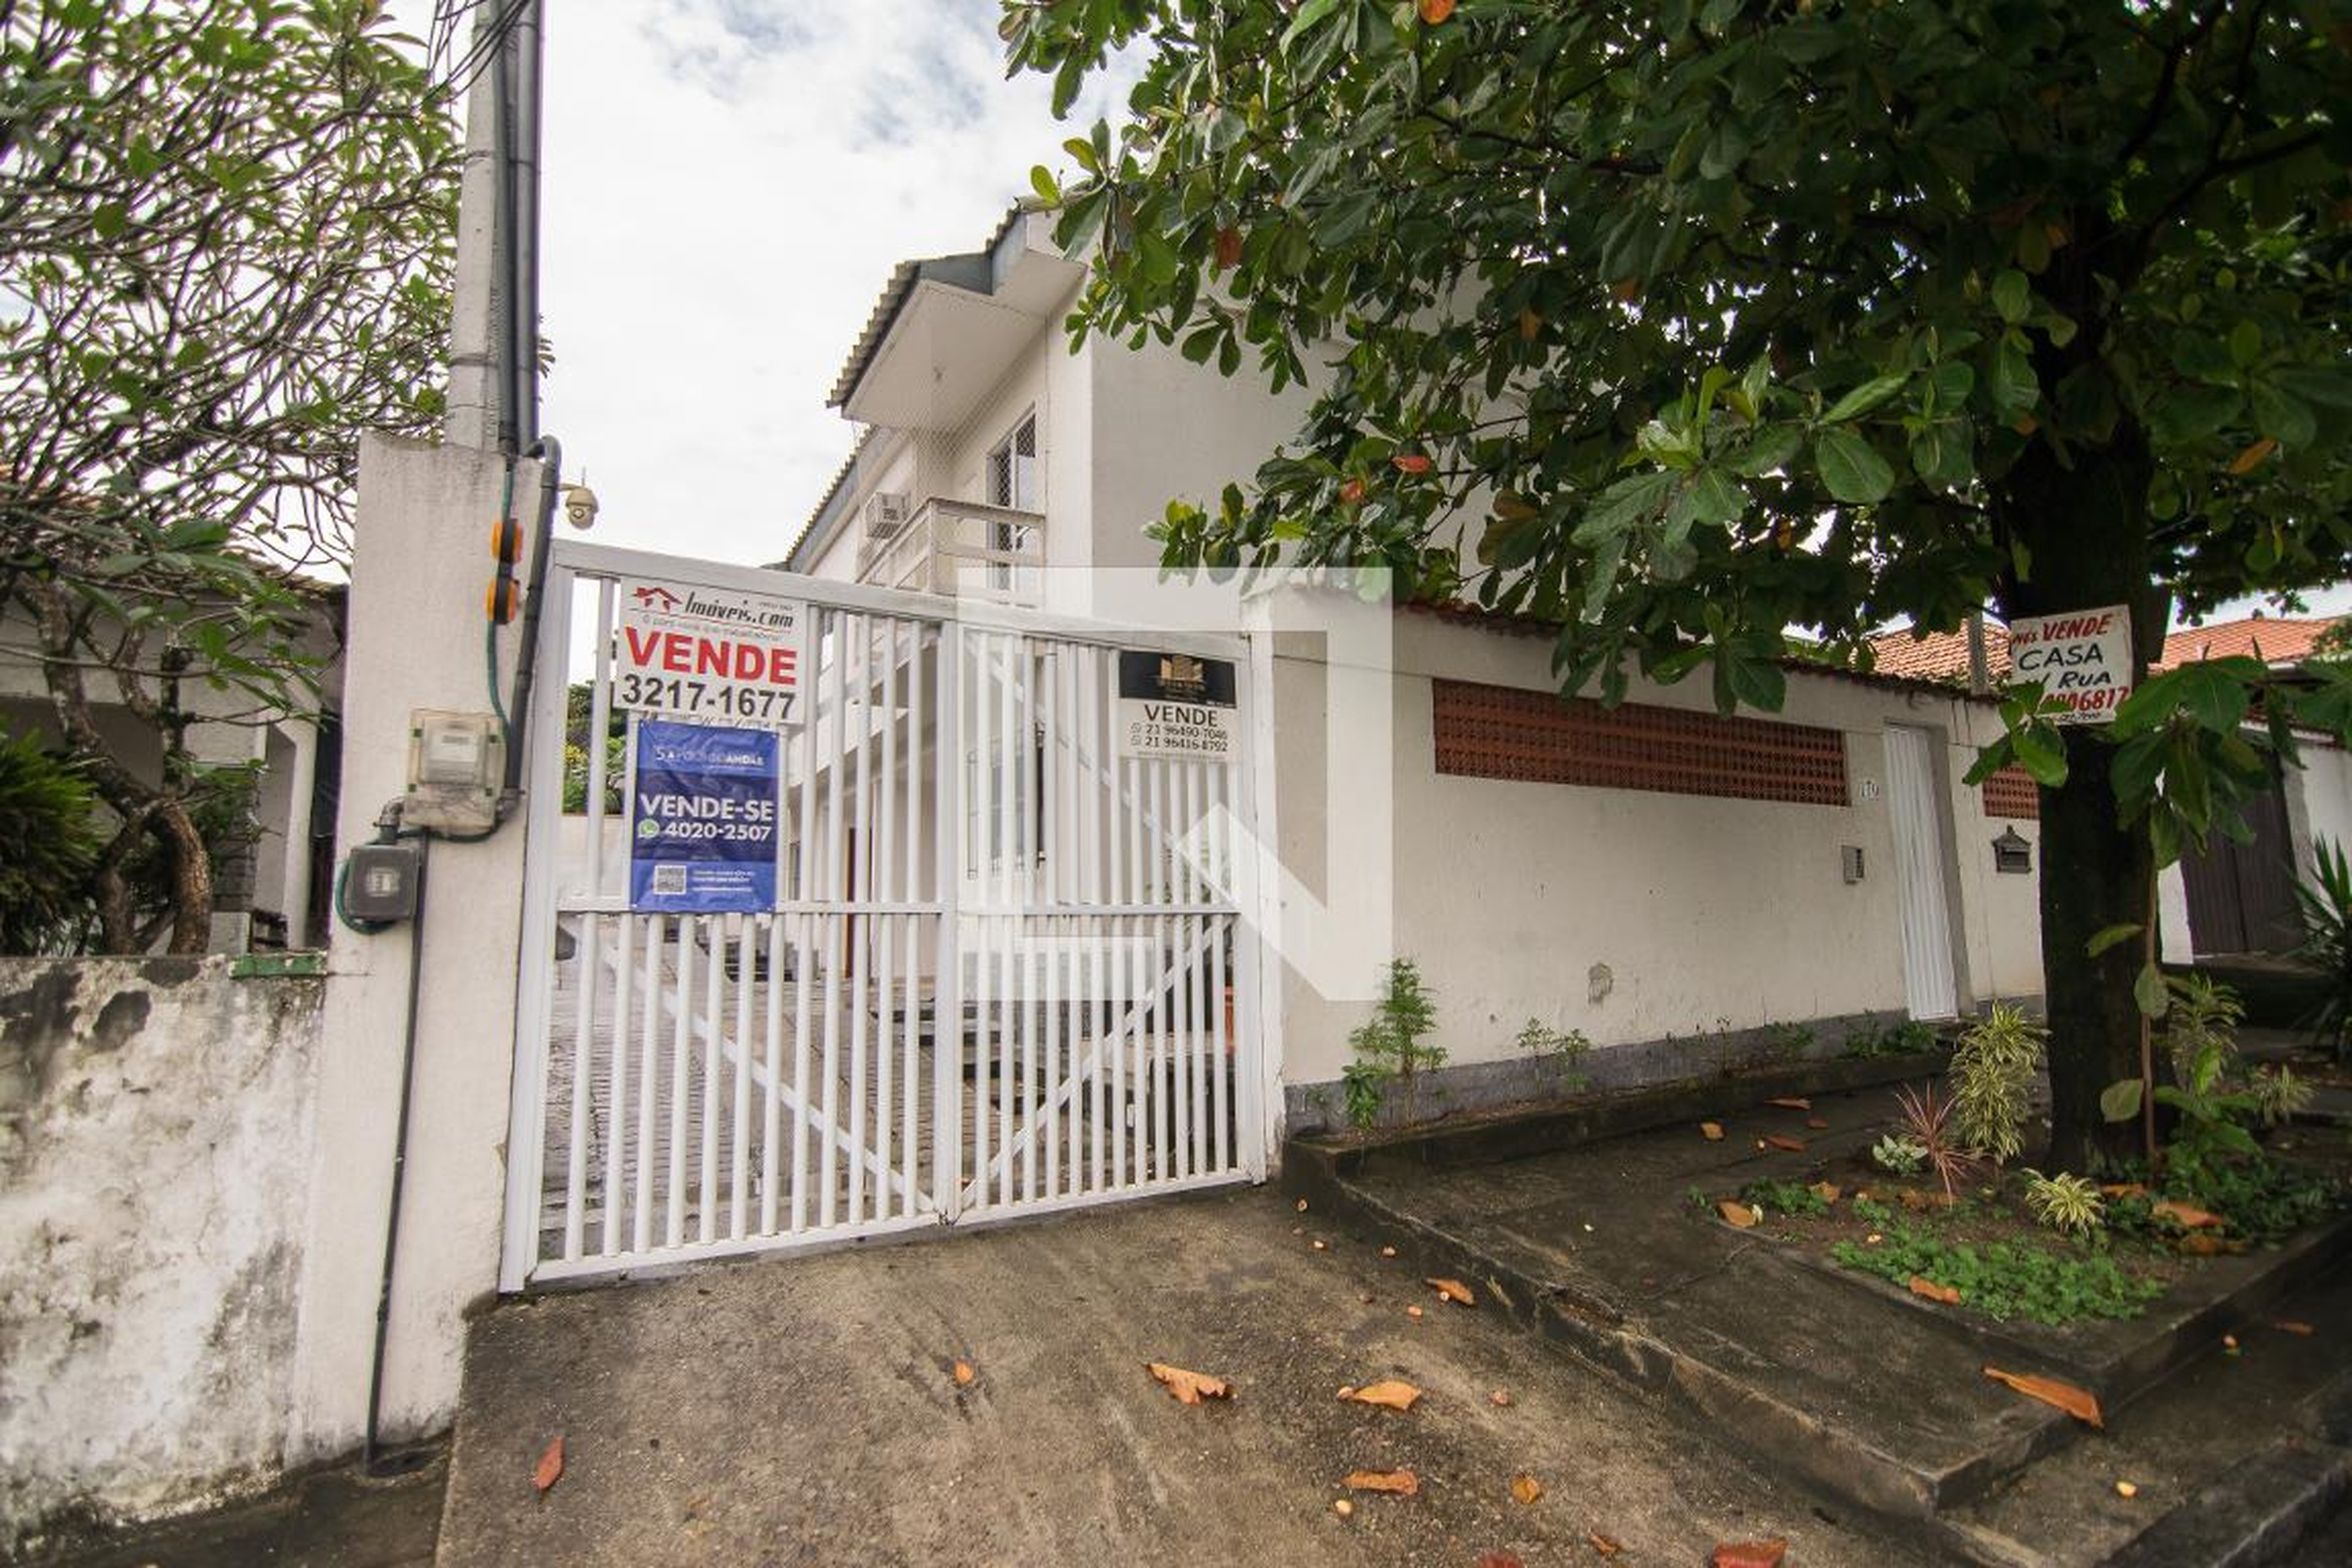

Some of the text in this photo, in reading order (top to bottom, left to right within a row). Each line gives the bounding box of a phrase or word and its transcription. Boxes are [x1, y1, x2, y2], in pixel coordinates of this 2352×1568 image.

[2043, 613, 2113, 641] VENDE
[625, 625, 797, 685] VENDE
[2018, 643, 2103, 671] CASA
[2058, 671, 2112, 688] RUA
[622, 673, 796, 719] 3217-1677
[1144, 704, 1218, 727] VENDE
[1145, 736, 1159, 748] 21
[640, 793, 774, 821] VENDE-SE
[665, 822, 772, 842] 4020-2507
